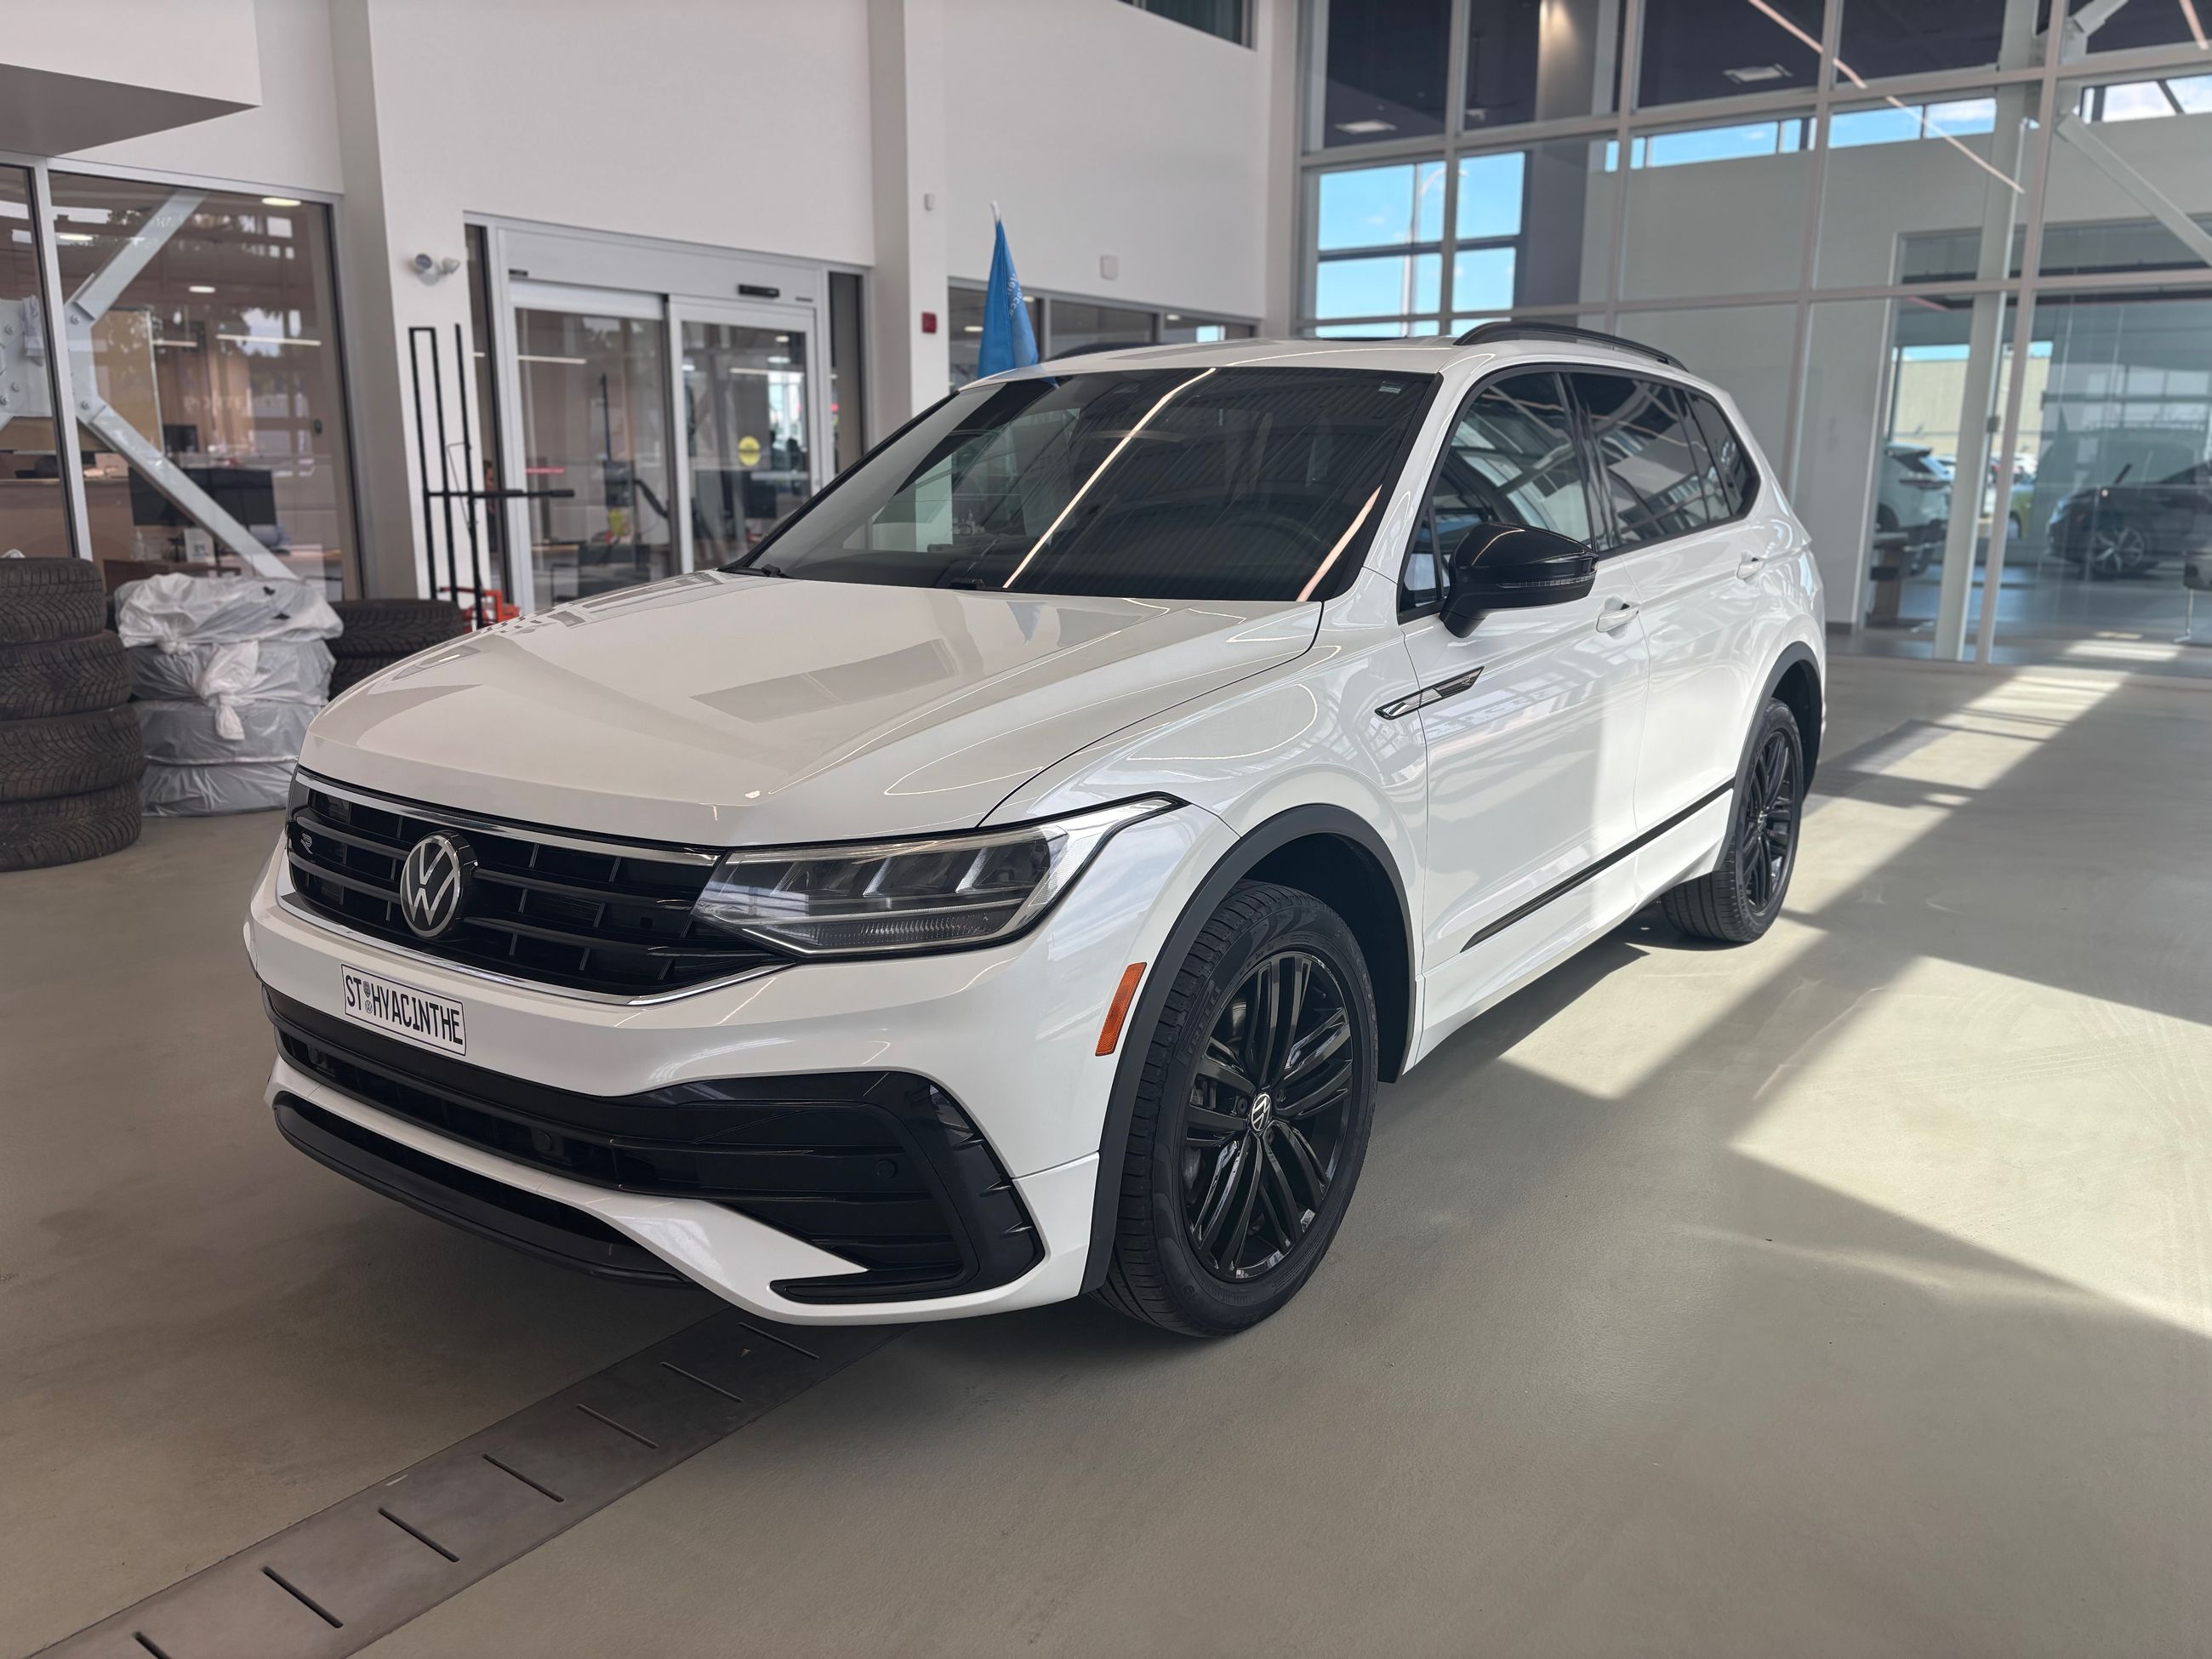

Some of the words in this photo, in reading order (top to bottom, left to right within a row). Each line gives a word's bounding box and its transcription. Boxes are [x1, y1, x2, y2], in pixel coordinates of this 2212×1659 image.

[400, 833, 461, 938] VW
[345, 974, 362, 1011] ST
[371, 983, 464, 1046] HYACINTHE
